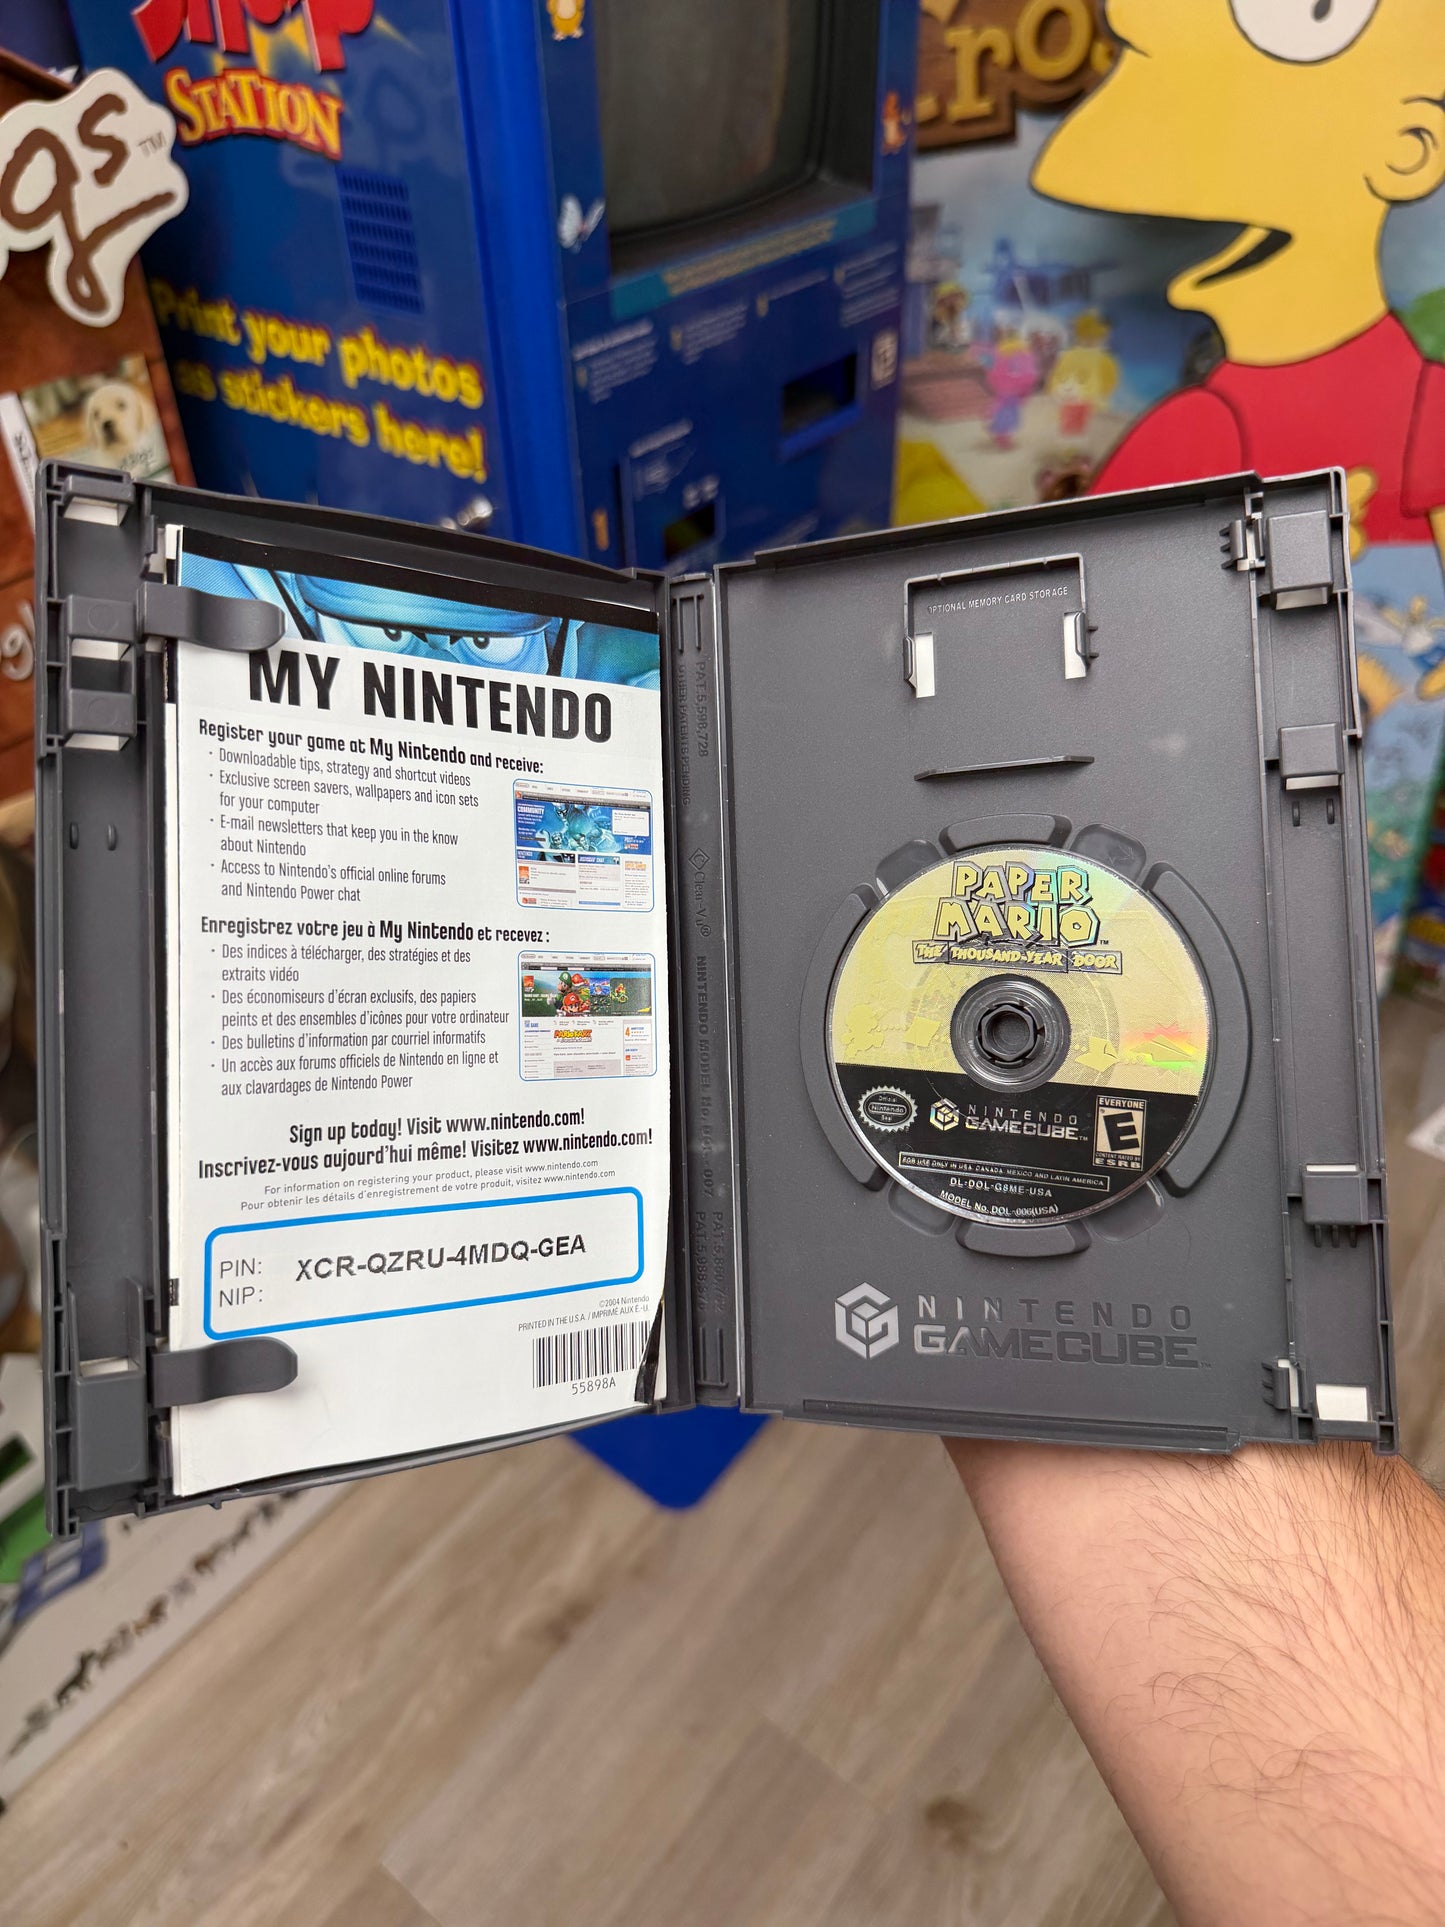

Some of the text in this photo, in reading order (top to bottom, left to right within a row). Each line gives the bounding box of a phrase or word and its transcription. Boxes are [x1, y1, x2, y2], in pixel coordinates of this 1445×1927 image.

[151, 279, 485, 410] Print your photos
[219, 369, 370, 447] stickers
[373, 402, 488, 484] here!
[928, 586, 1068, 614] OPTIONAL MEMORY CARD STORAGE
[249, 649, 612, 743] MY NINTENDO
[200, 719, 543, 773] Register your game at My Nintendo and receive:
[220, 748, 470, 786] Downloadable tips, strategy and shortcut videos
[220, 770, 478, 807] Exclusive screen savers, wallpapers and icon sets
[220, 792, 320, 815] for your computer
[221, 859, 260, 875] Access
[264, 862, 275, 875] to
[340, 866, 374, 881] official
[379, 869, 408, 883] online
[412, 870, 446, 885] forums
[952, 861, 1093, 905] PAPER
[222, 882, 360, 901] and Nintendo Power chat
[202, 916, 292, 938] Enregistrez
[297, 920, 338, 936] votre
[342, 921, 363, 941] jeu
[368, 921, 375, 937] à
[380, 920, 402, 943] My
[408, 921, 473, 940] Nintendo
[478, 927, 492, 941] et
[933, 897, 1101, 947] MARIO
[916, 942, 1120, 970] THE THOUSAND-YEAR DOOR
[223, 990, 243, 1003] Des
[247, 989, 324, 1003] économiseurs
[370, 990, 416, 1005] exclusifs,
[420, 990, 437, 1003] des
[441, 990, 476, 1006] papiers
[223, 1036, 242, 1049] Des
[247, 1034, 294, 1049] bulletins
[372, 1035, 388, 1049] par
[392, 1031, 429, 1045] courriel
[433, 1030, 485, 1044] informatifs
[871, 1104, 904, 1113] Nintendo
[968, 1104, 1078, 1125] NINTENDO
[1098, 1098, 1144, 1110] EVERYONE
[290, 1108, 584, 1147] Sign up today! Visit www.nintendo.com!
[965, 1116, 1079, 1140] GAMECUBE
[1103, 1112, 1140, 1151] E
[199, 1155, 318, 1179] Inscrivez-vous
[418, 1140, 466, 1161] même!
[471, 1139, 519, 1157] Visitez
[523, 1128, 652, 1153] www.nintendo.com!
[1095, 1158, 1141, 1168] ESRB
[265, 1186, 281, 1194] For
[284, 1180, 339, 1193] information
[358, 1175, 409, 1187] registering
[413, 1174, 432, 1183] your
[436, 1170, 472, 1182] product,
[475, 1168, 503, 1179] please
[506, 1165, 522, 1174] visit
[525, 1161, 598, 1172] www.nintendo.com
[902, 1156, 916, 1164] FOR
[917, 1158, 930, 1166] USE
[932, 1160, 948, 1168] ONLY
[1006, 1168, 1032, 1177] MEXICO
[1050, 1174, 1070, 1182] LATIN
[1072, 1177, 1104, 1186] AMERICA
[241, 1202, 264, 1210] Pour
[268, 1196, 303, 1208] obtenir
[306, 1196, 319, 1204] les
[323, 1192, 355, 1202] détails
[442, 1184, 452, 1192] de
[481, 1179, 513, 1191] produit,
[516, 1177, 541, 1185] visitez
[544, 1171, 615, 1182] www.nintendo.com
[940, 1190, 972, 1208] MODEL
[221, 1258, 261, 1278] PIN:
[296, 1234, 586, 1281] XCR-QZRU-4MDQ-GEA
[220, 1287, 262, 1307] NIP:
[621, 1295, 650, 1304] Nintendo
[518, 1320, 546, 1332] PRINTED
[548, 1318, 554, 1326] IN
[556, 1316, 568, 1325] THE
[620, 1306, 634, 1315] AUX
[917, 1294, 1192, 1331] NINTENDO
[913, 1324, 1199, 1368] GAMECUBE
[572, 1376, 616, 1396] 55898A
